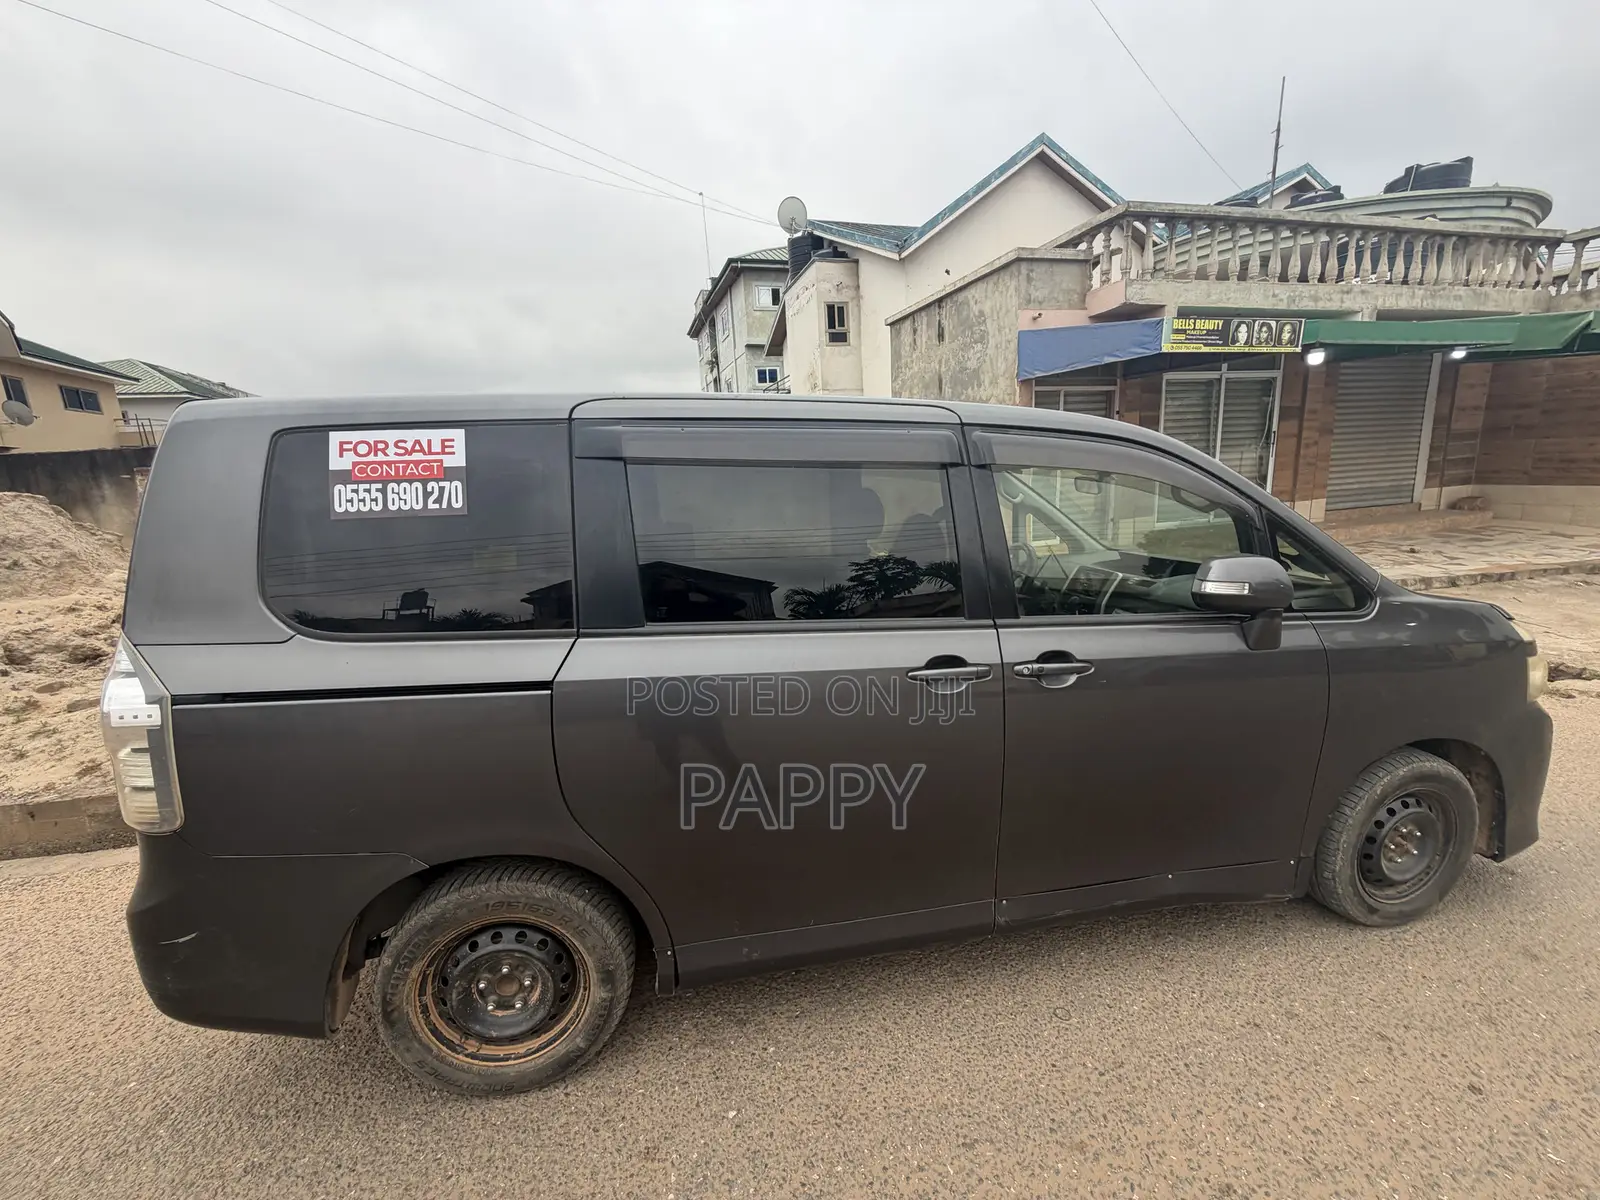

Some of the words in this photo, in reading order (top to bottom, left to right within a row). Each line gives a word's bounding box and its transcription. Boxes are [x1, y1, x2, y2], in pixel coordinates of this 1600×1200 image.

[1173, 318, 1194, 330] BELLS
[1195, 319, 1224, 330] BEAUTY
[338, 440, 389, 459] FOR
[393, 438, 456, 457] SALE
[354, 462, 441, 477] CONTACT
[333, 483, 383, 513] 0555
[387, 481, 424, 511] 690
[426, 480, 463, 509] 270
